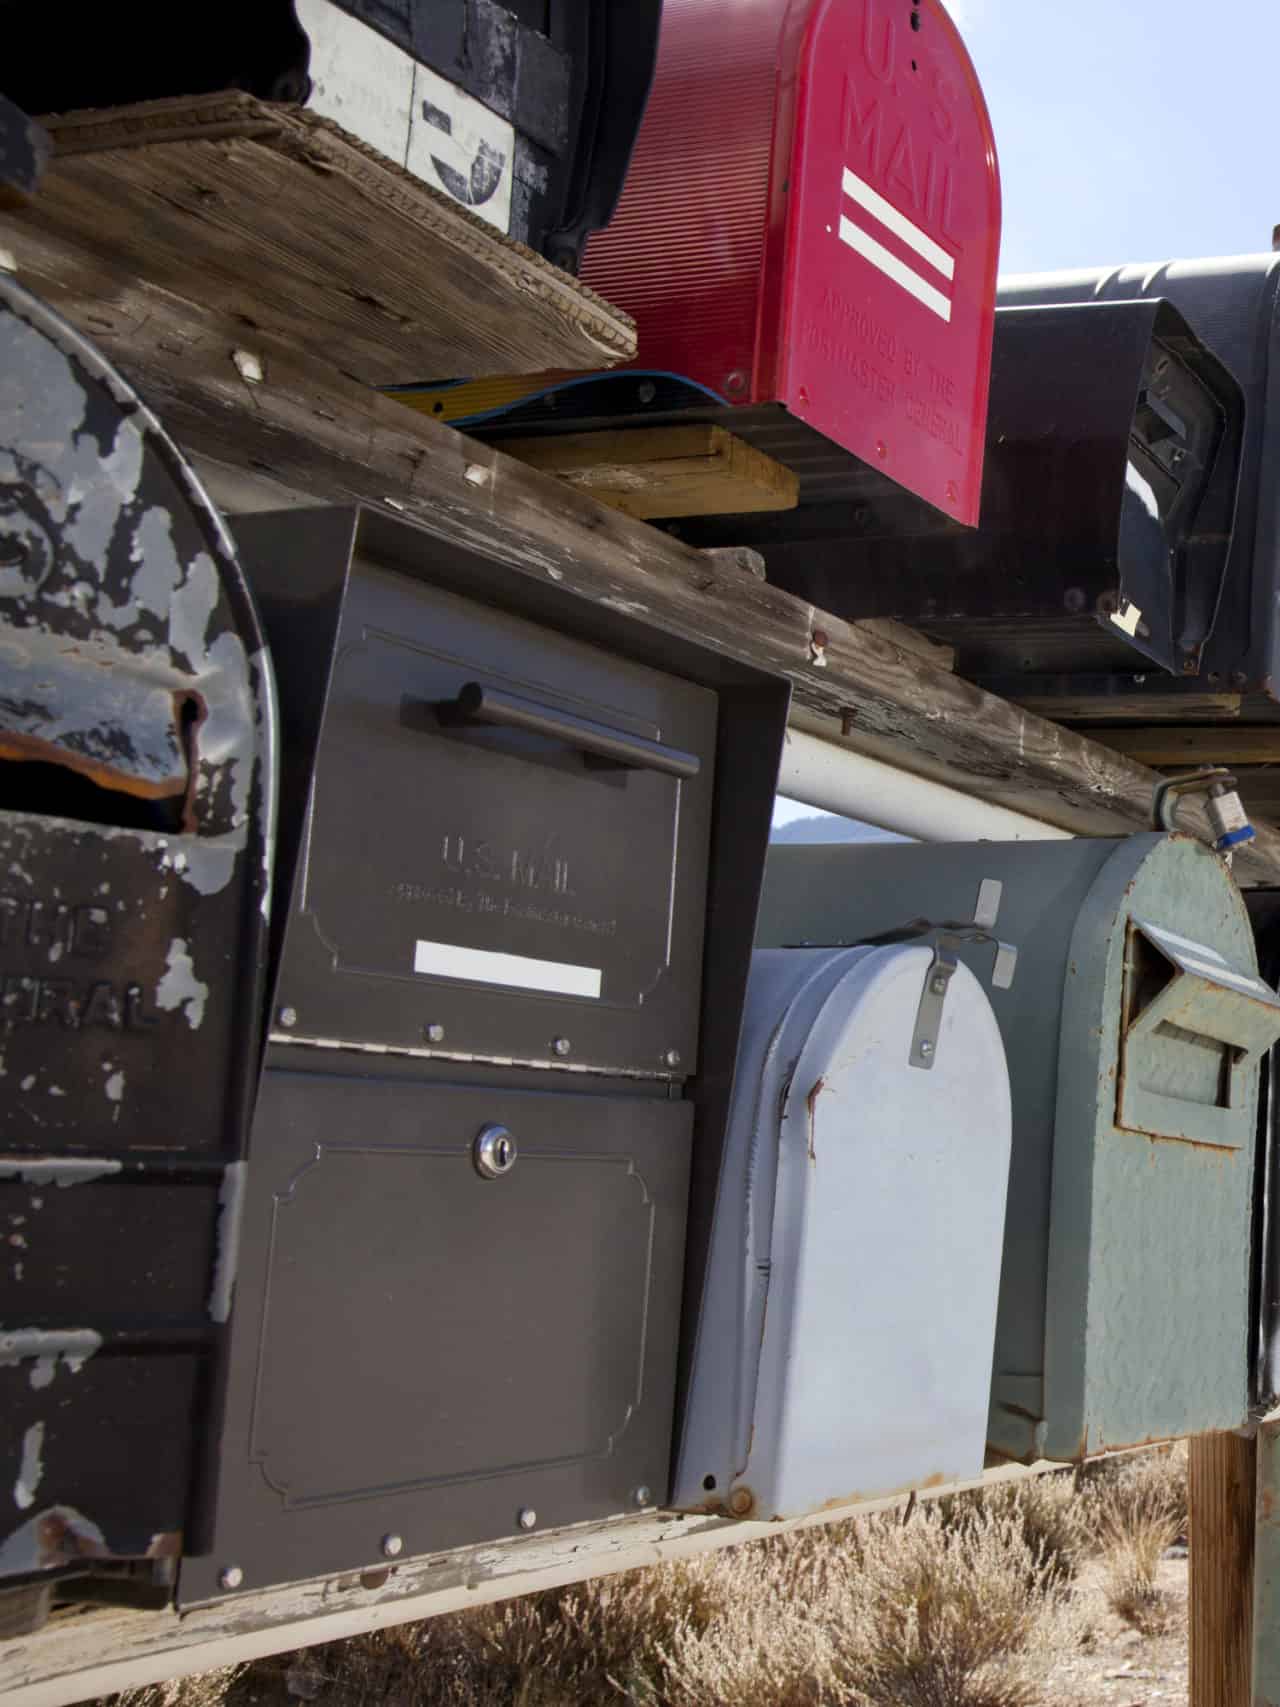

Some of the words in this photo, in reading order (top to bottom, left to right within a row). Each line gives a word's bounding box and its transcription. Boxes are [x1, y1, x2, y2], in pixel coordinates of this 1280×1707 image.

[839, 72, 965, 252] MAIL
[799, 319, 898, 402] POSTMASTER
[903, 391, 965, 457] GENERAL
[822, 285, 898, 363] APPROVED
[927, 362, 957, 407] THE
